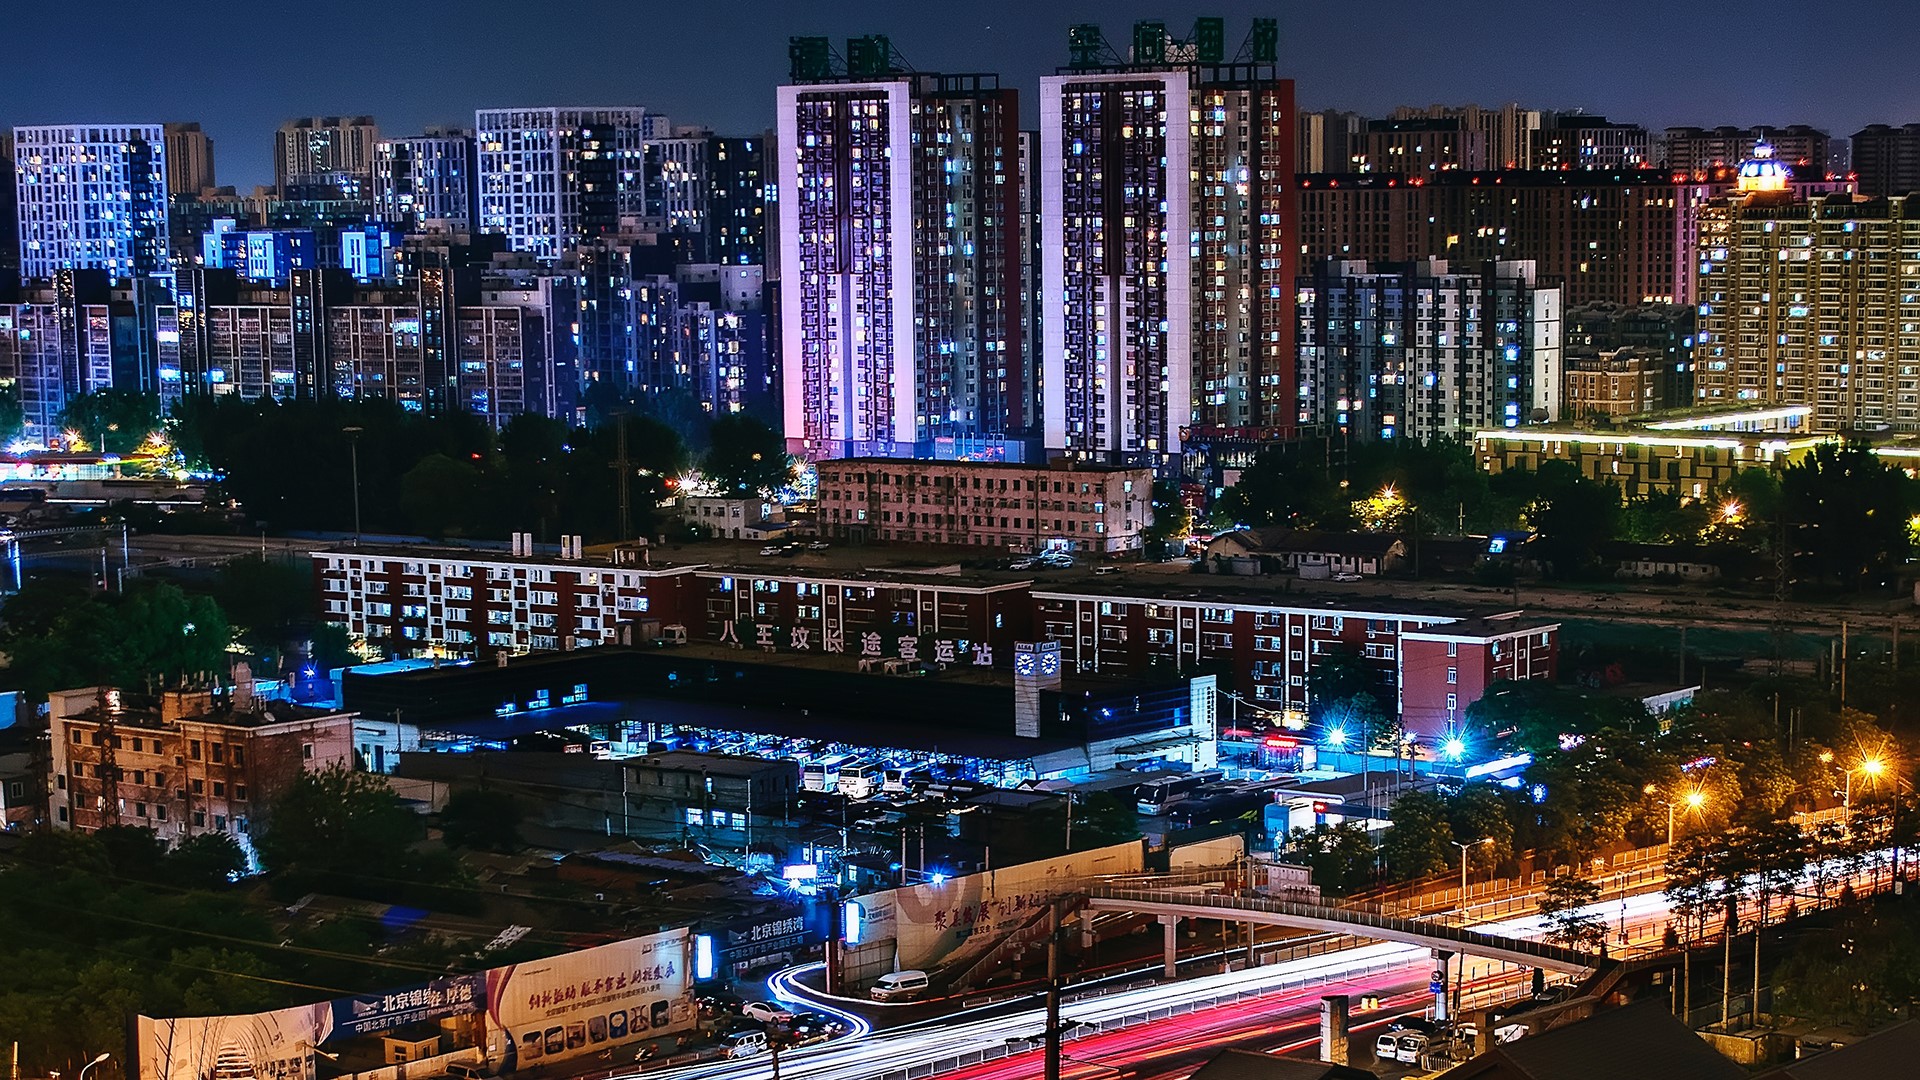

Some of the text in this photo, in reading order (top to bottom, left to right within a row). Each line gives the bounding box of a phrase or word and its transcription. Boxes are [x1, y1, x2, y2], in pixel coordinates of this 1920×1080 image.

[719, 620, 993, 665] 八王坟长途客运站
[753, 917, 803, 940] 北京锦绣湾
